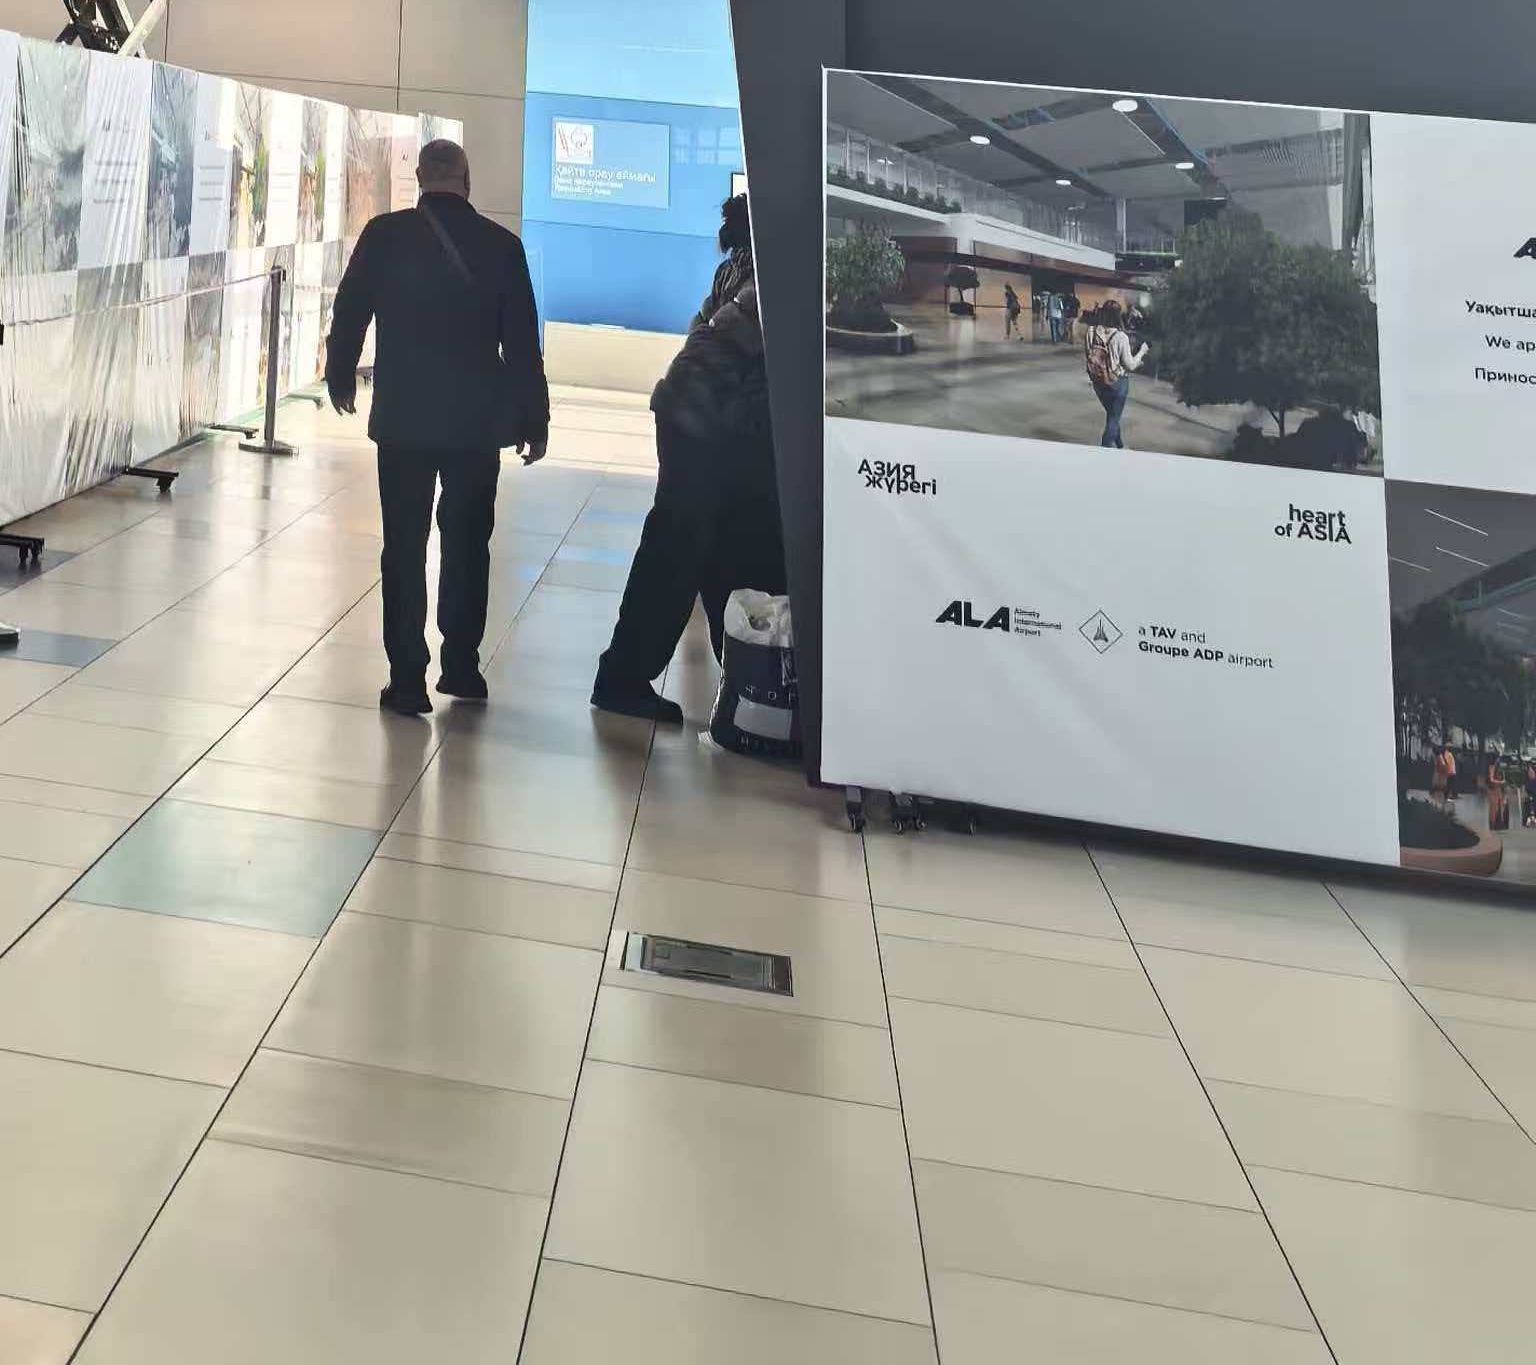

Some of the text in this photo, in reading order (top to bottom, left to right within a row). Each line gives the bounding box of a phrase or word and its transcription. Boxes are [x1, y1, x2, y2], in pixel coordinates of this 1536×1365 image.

[1485, 334, 1511, 349] We
[857, 458, 915, 480] АЗИЯ
[1289, 503, 1346, 526] heart
[1274, 522, 1352, 544] of ASIA
[935, 600, 1010, 633] ALA
[1138, 626, 1206, 644] a TAV and
[1138, 640, 1274, 669] Groupe ADP airport
